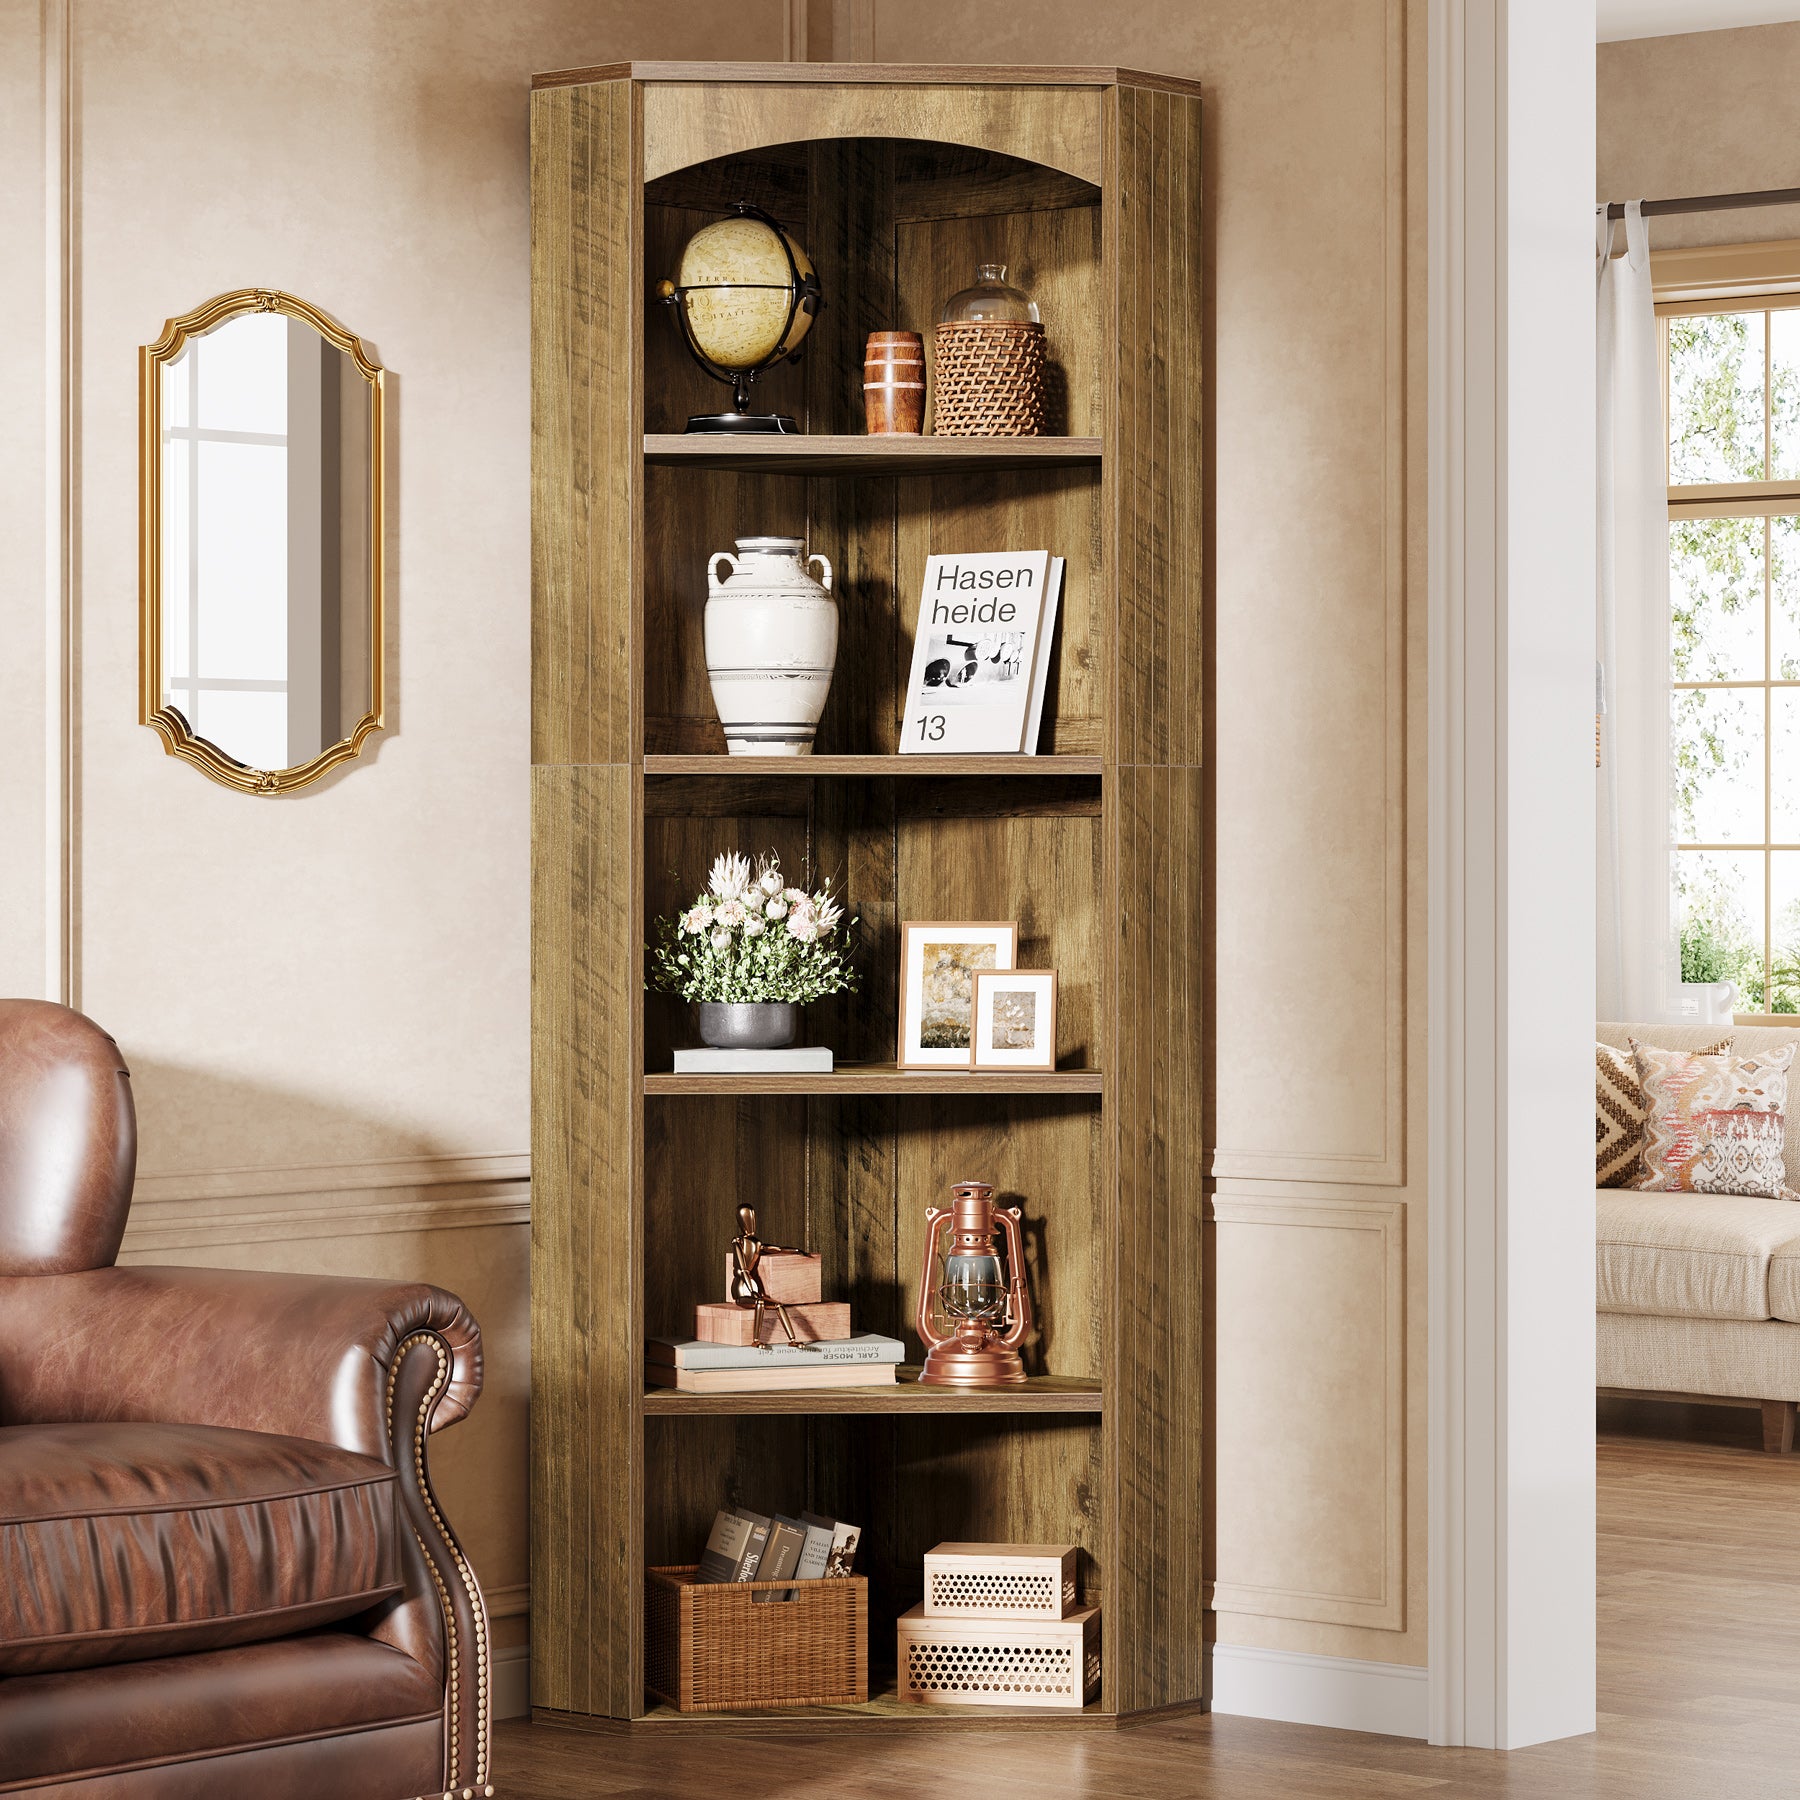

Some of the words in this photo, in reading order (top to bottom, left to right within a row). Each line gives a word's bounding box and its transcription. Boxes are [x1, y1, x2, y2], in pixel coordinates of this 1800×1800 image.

[936, 565, 1033, 591] Hasen
[931, 597, 1017, 624] heide
[916, 715, 946, 741] 13
[833, 1345, 880, 1353] Architektur
[737, 1552, 759, 1583] Sherloc
[771, 1545, 790, 1577] Dreaming
